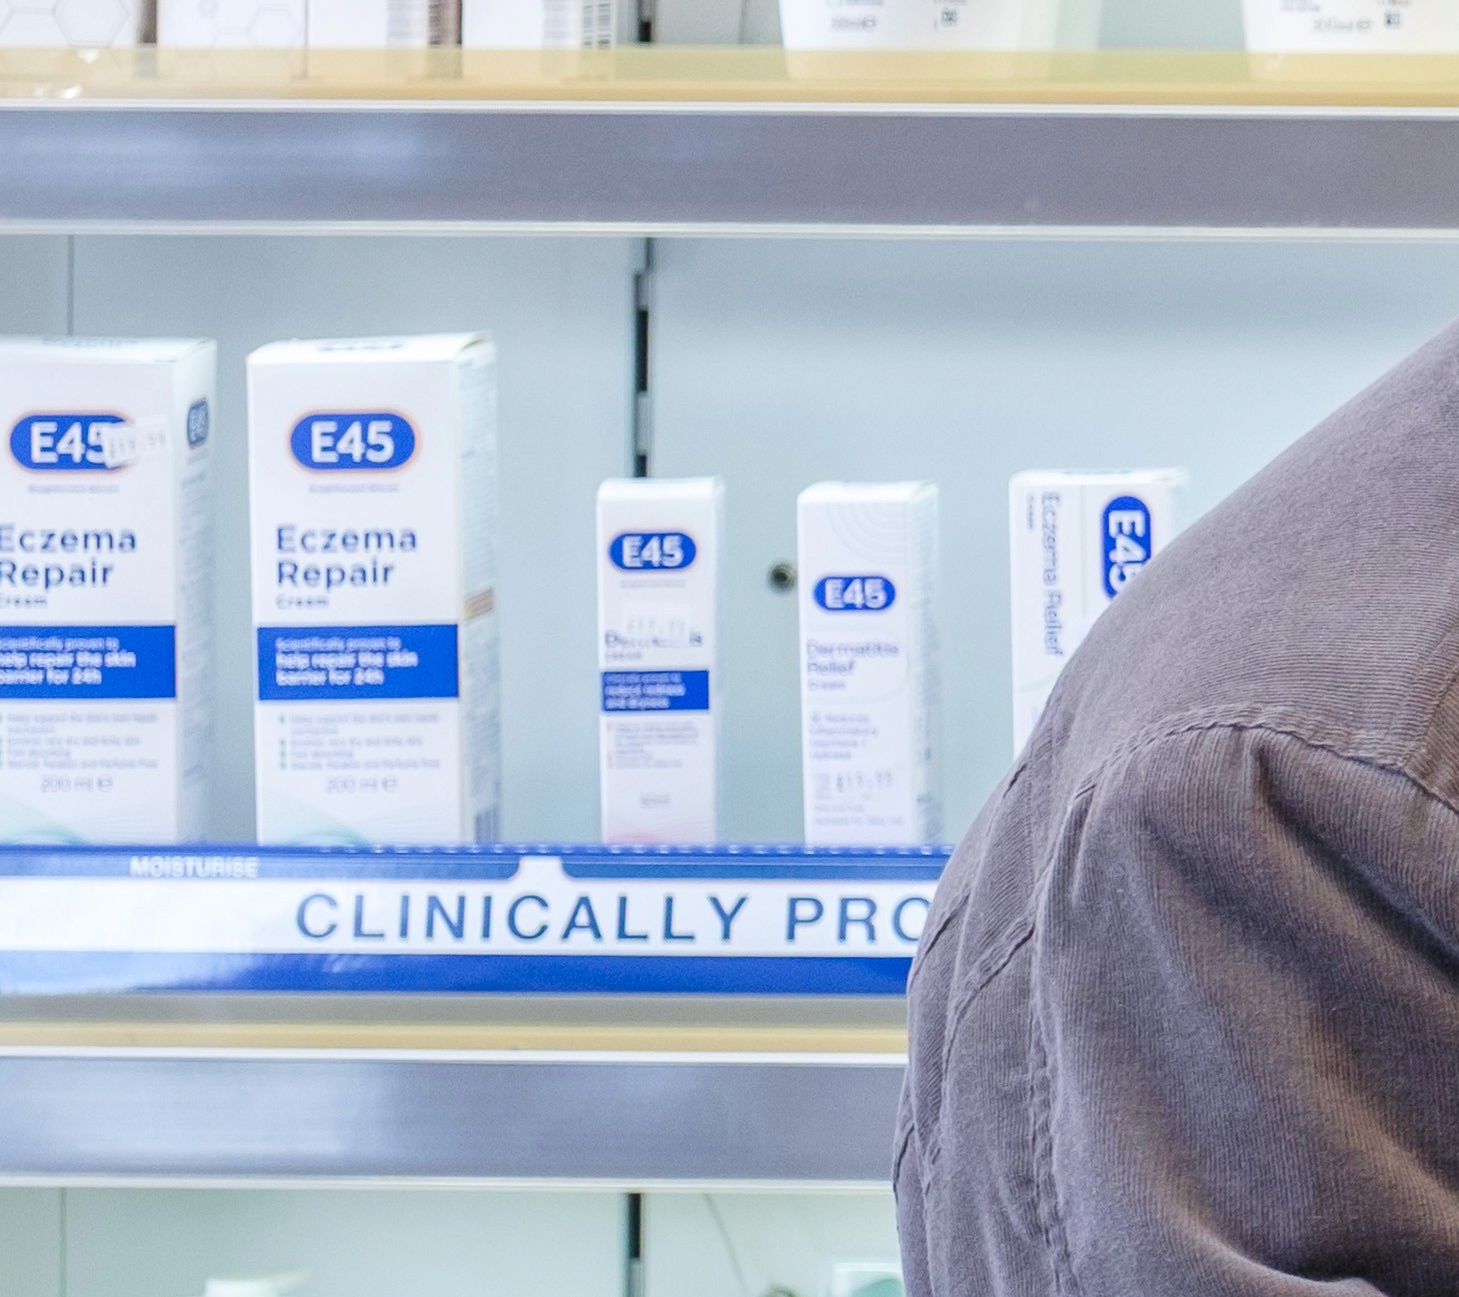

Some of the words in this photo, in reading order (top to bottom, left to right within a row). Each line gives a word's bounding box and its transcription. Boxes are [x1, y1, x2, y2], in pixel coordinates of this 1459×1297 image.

[311, 420, 395, 464] E45
[0, 523, 137, 554] Eczema
[276, 523, 417, 554] Eczema
[621, 535, 685, 568] E45
[0, 559, 115, 592] Repair
[276, 558, 395, 593] Repair
[824, 578, 887, 610] E45
[129, 855, 259, 878] MOISTURISE
[294, 892, 750, 943] CLINICALLY
[785, 893, 937, 944] PRO
